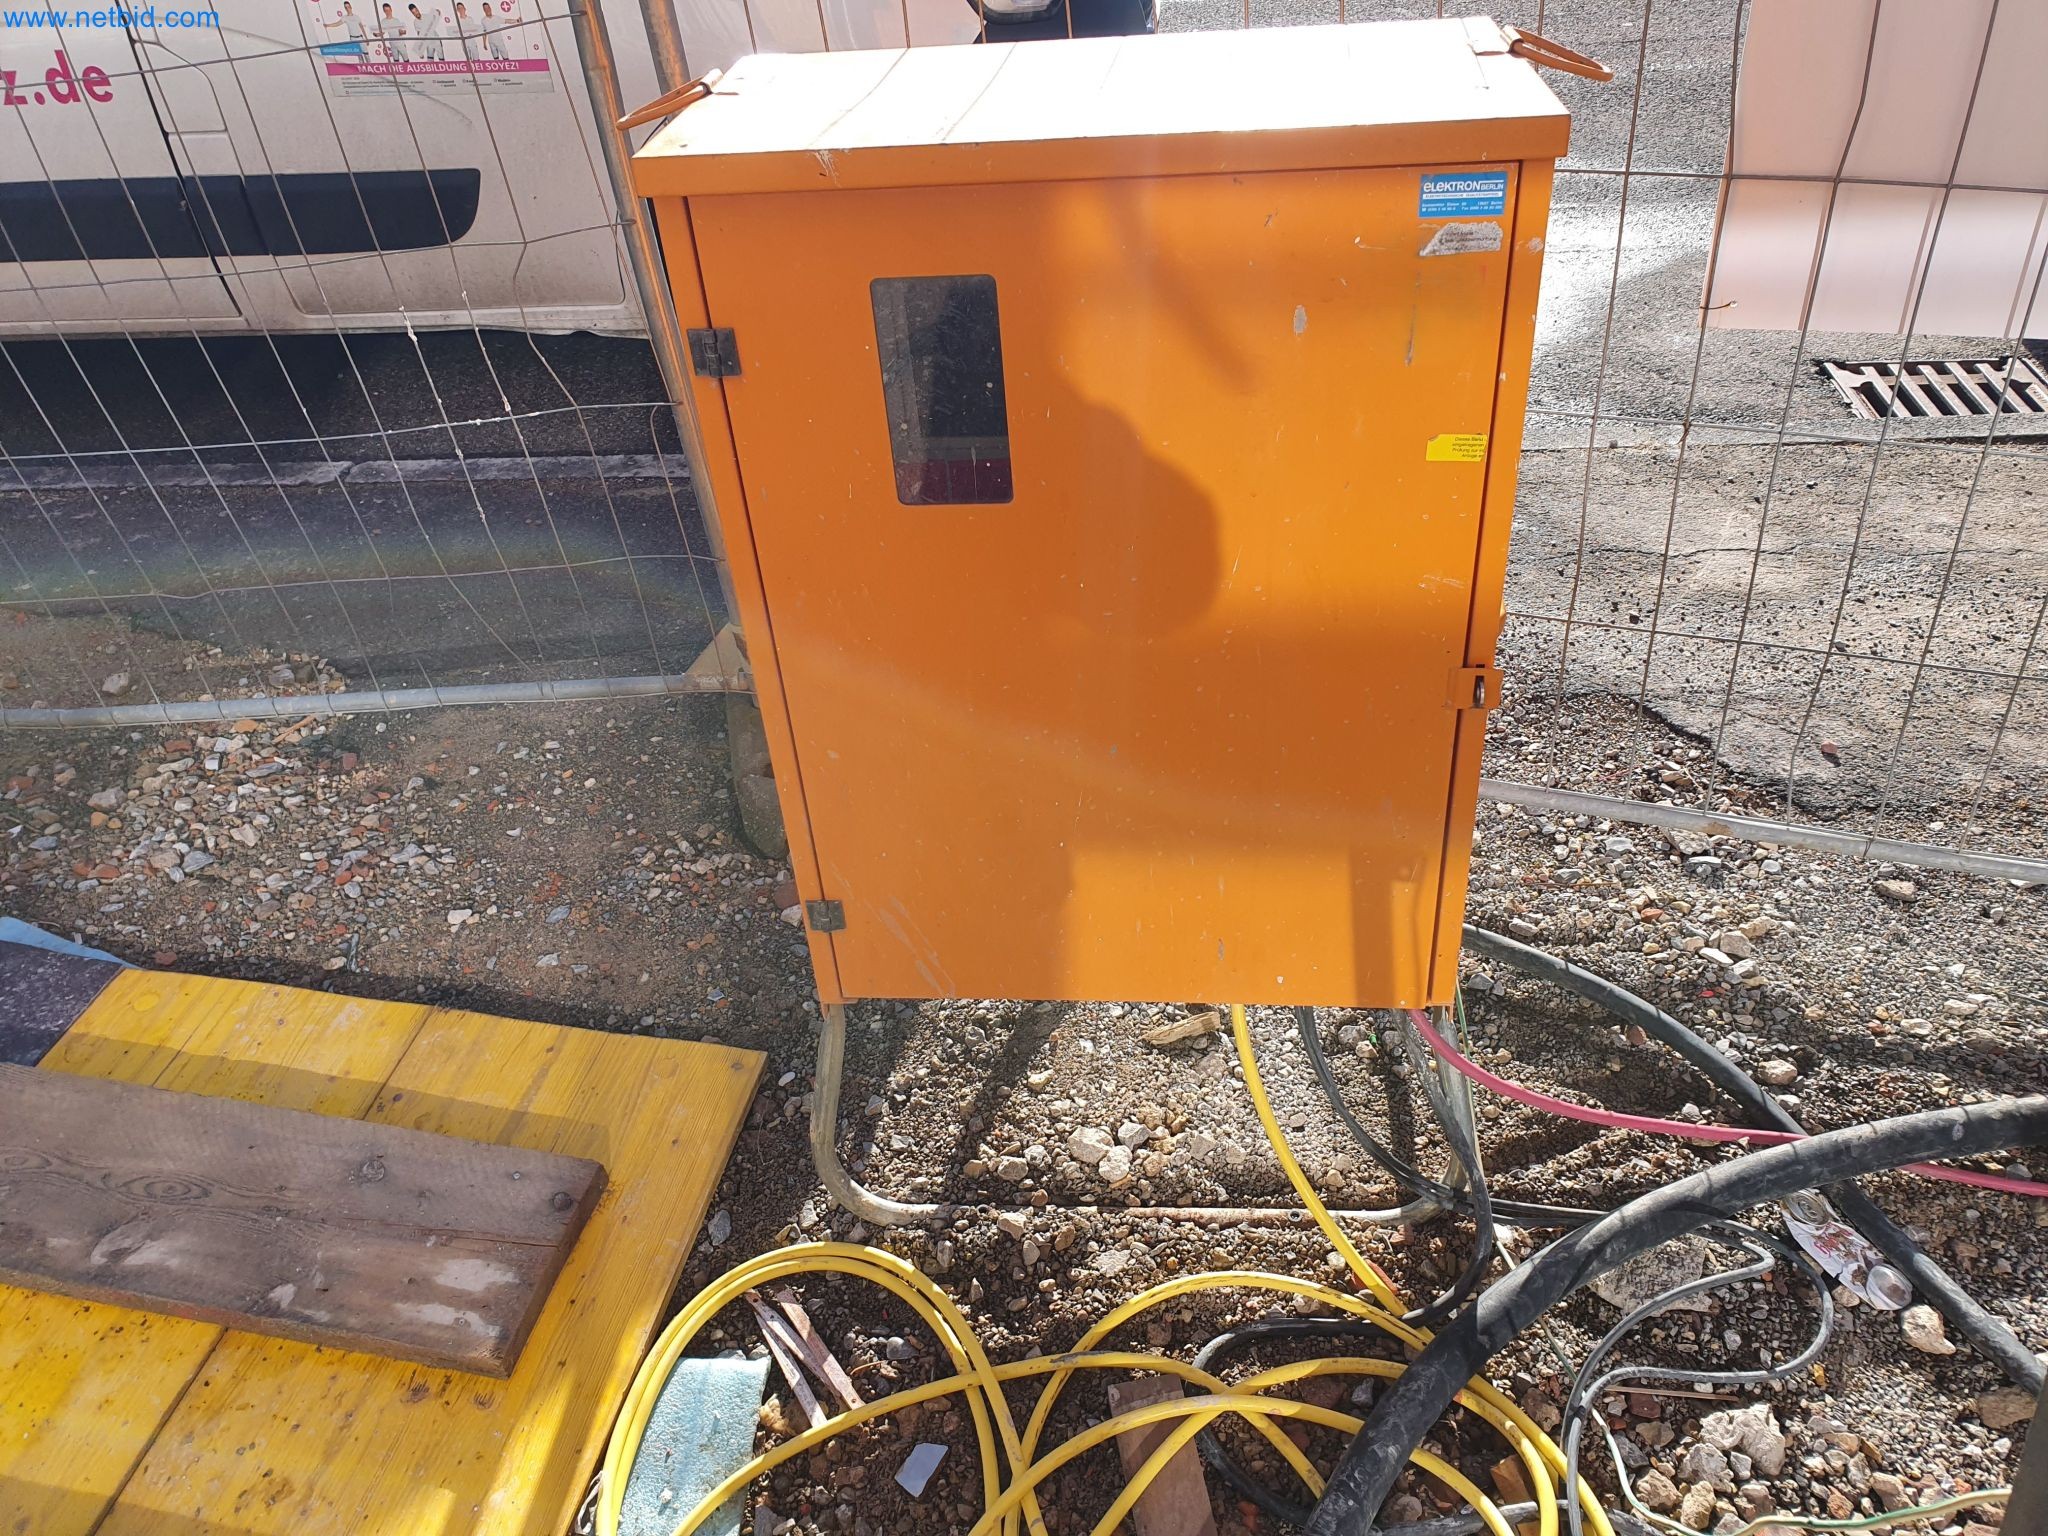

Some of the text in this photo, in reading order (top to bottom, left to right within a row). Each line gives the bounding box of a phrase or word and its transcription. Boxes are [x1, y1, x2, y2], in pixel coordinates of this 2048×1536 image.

[357, 65, 387, 74] MACH
[389, 64, 404, 73] DIE
[407, 63, 467, 73] AUSBILDUNG
[485, 62, 519, 71] SOYEZ!
[0, 49, 114, 106] z.de
[1480, 183, 1504, 191] BERLIN
